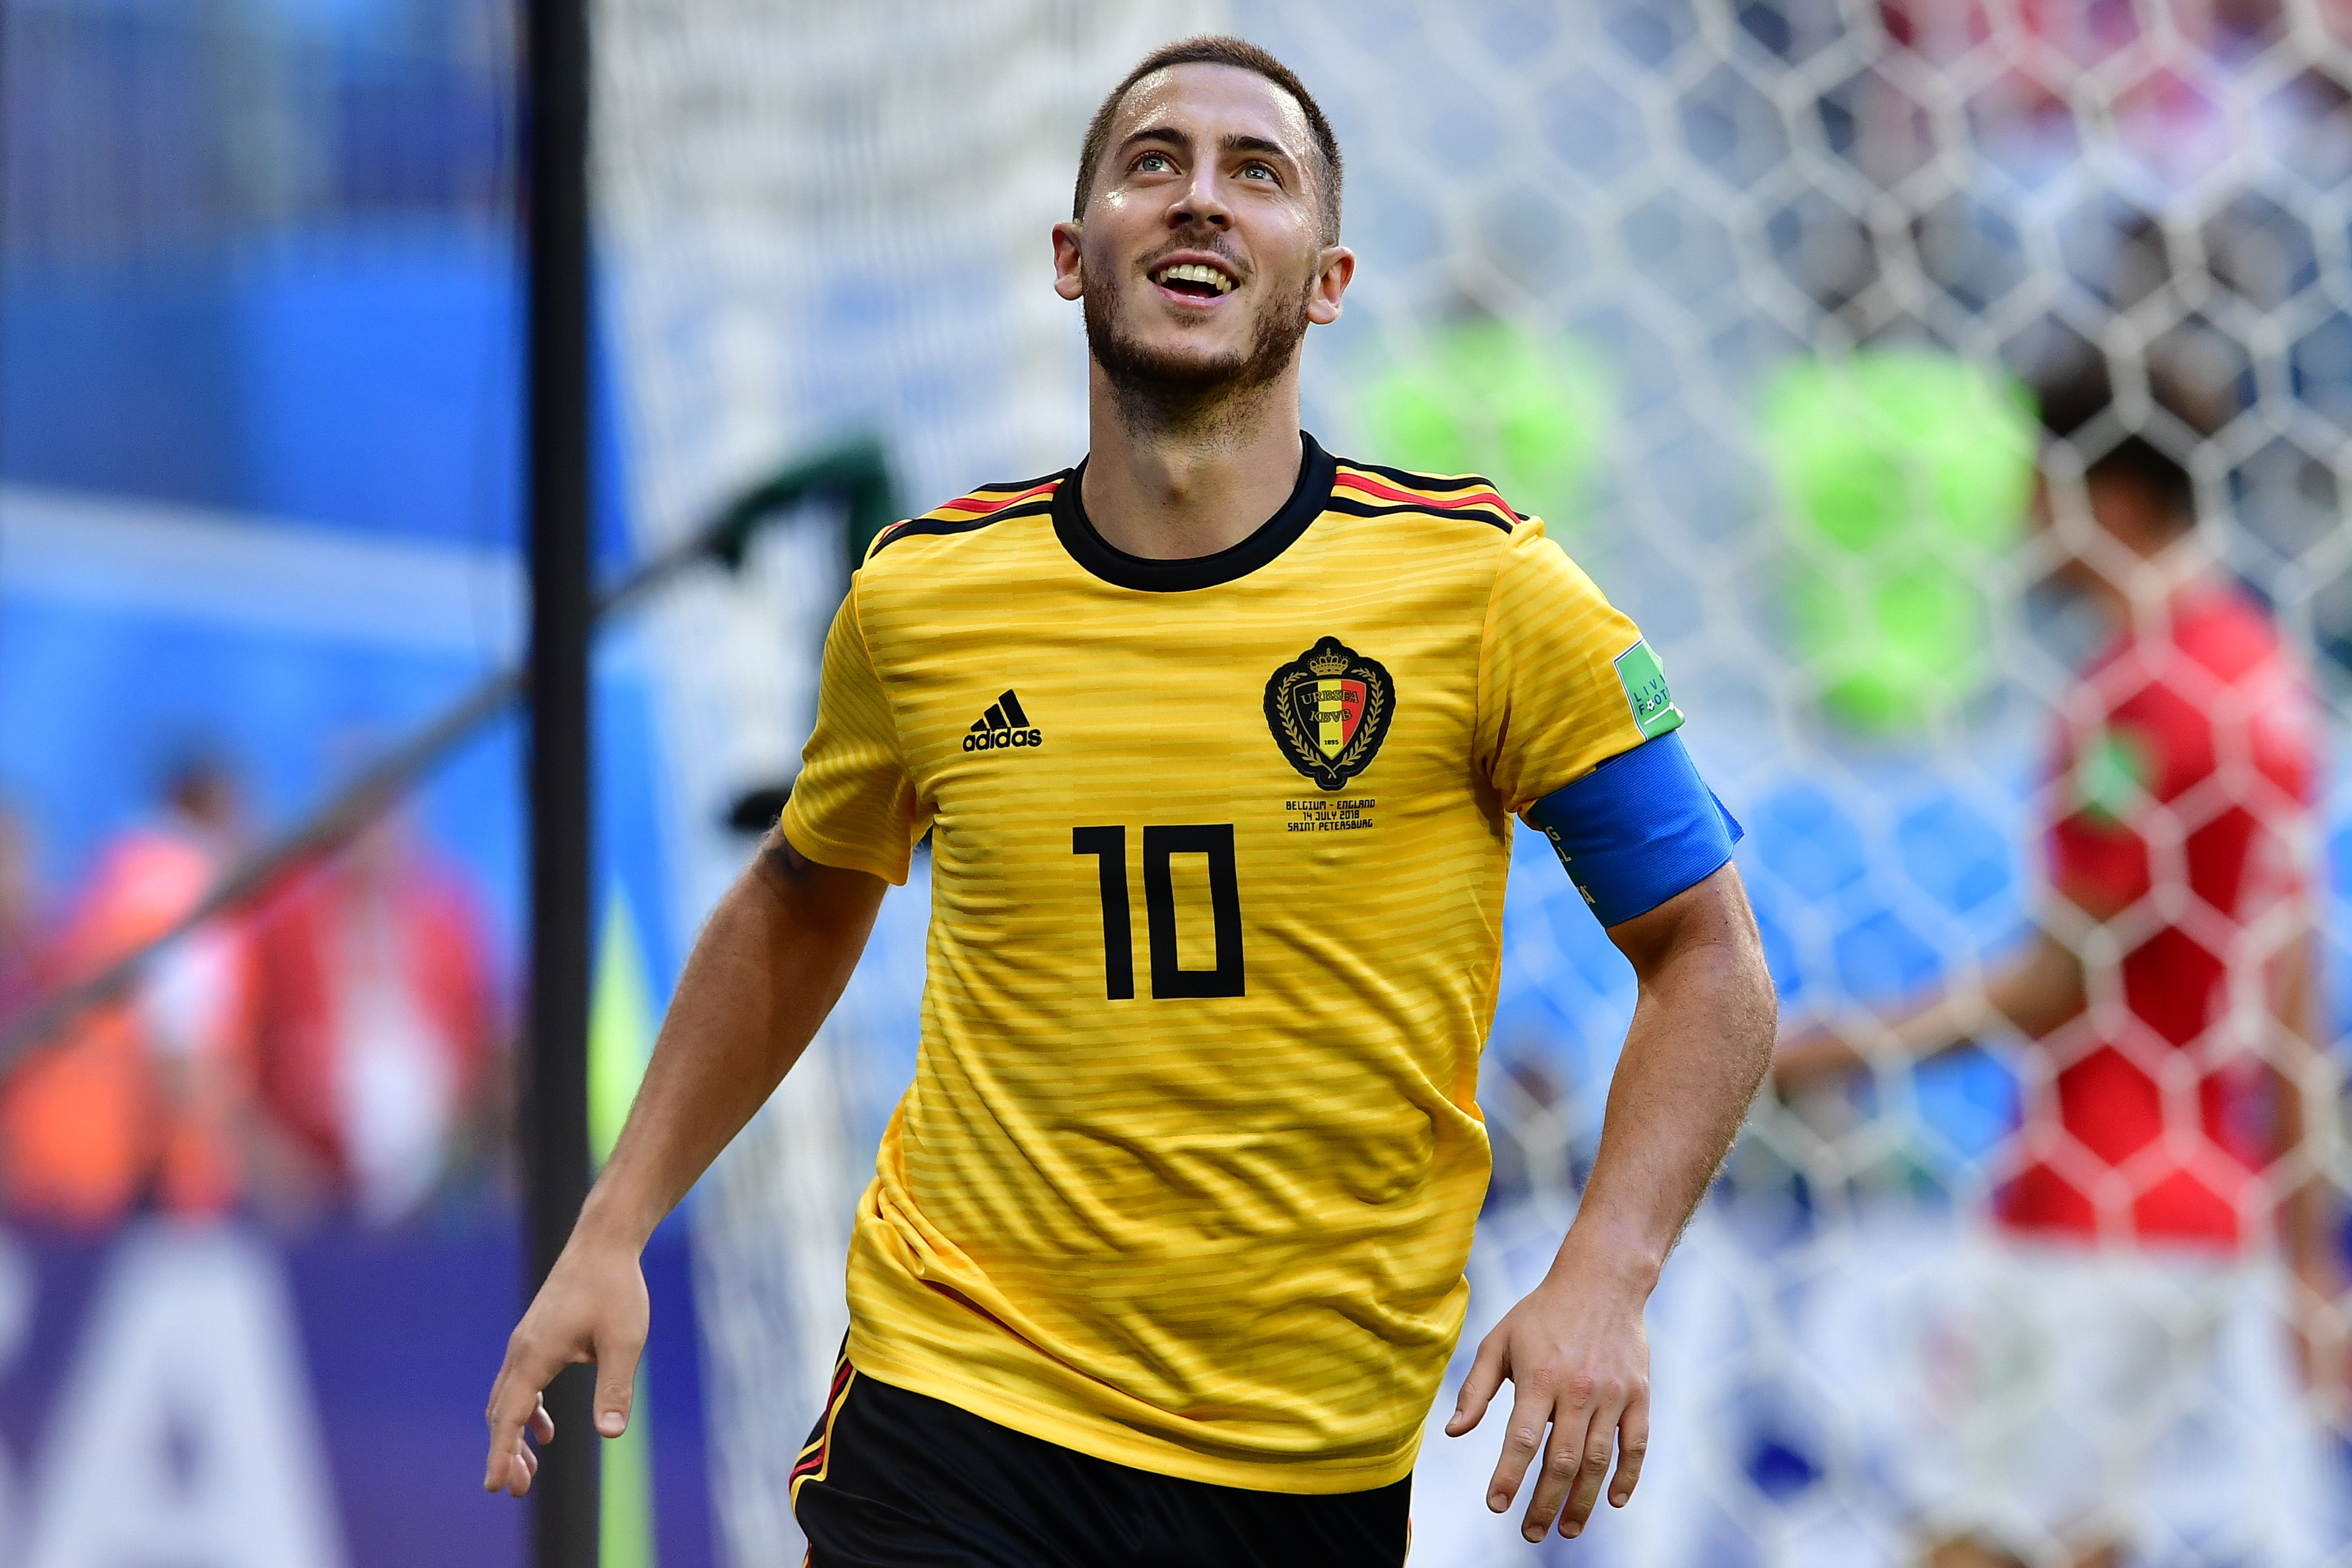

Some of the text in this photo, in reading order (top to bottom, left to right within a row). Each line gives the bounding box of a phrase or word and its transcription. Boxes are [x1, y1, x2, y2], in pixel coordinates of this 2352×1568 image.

[1300, 689, 1359, 705] URBSFA
[1309, 709, 1352, 723] KBVB
[963, 727, 1042, 752] adidas
[1286, 801, 1326, 810] BELGIUM
[1337, 799, 1375, 810] ENGLAND
[1303, 810, 1360, 821] 14 JULY 2018
[1287, 819, 1373, 832] SAINT PETERSBURG
[1073, 823, 1245, 1000] 10
